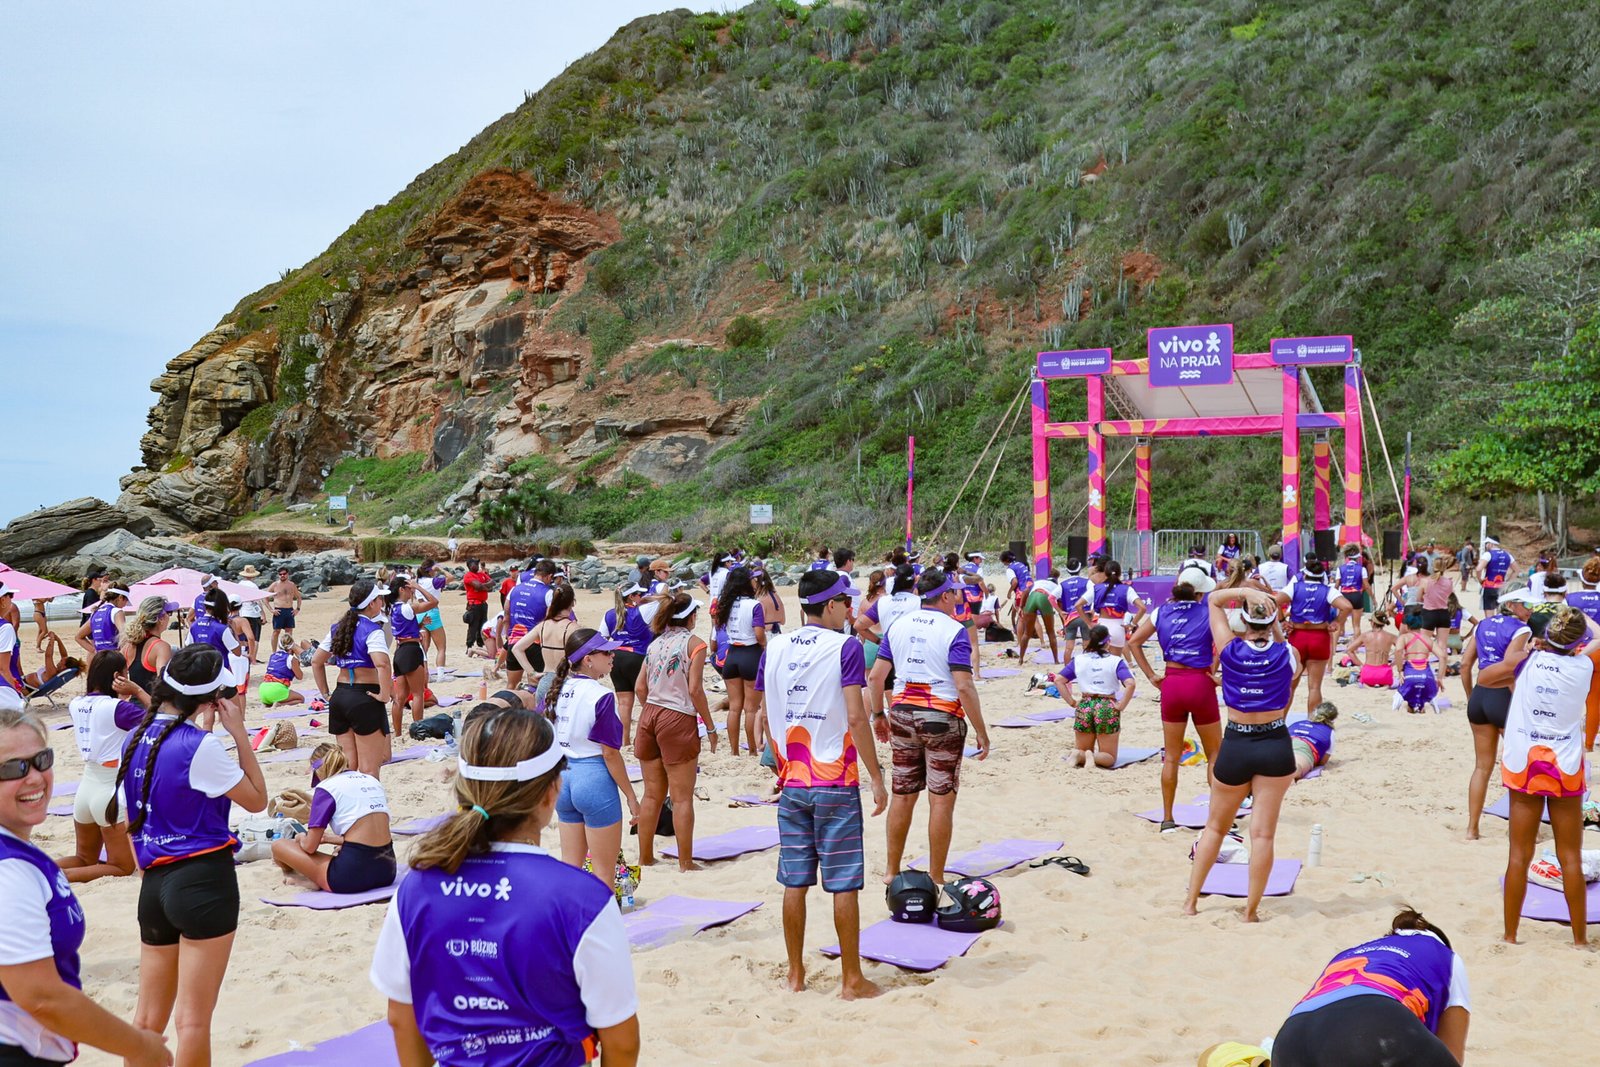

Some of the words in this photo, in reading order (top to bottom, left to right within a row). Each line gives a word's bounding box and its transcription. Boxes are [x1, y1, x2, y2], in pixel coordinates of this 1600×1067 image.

[1159, 335, 1204, 354] vivo
[1160, 357, 1179, 369] NA
[1180, 354, 1222, 368] PRAIA
[790, 635, 812, 646] vivo
[1536, 663, 1554, 672] vivo
[1539, 710, 1557, 718] PECK
[440, 876, 492, 897] vivo
[470, 939, 498, 955] BÚZIOS
[487, 1034, 507, 1046] RIO
[508, 1033, 522, 1045] DE
